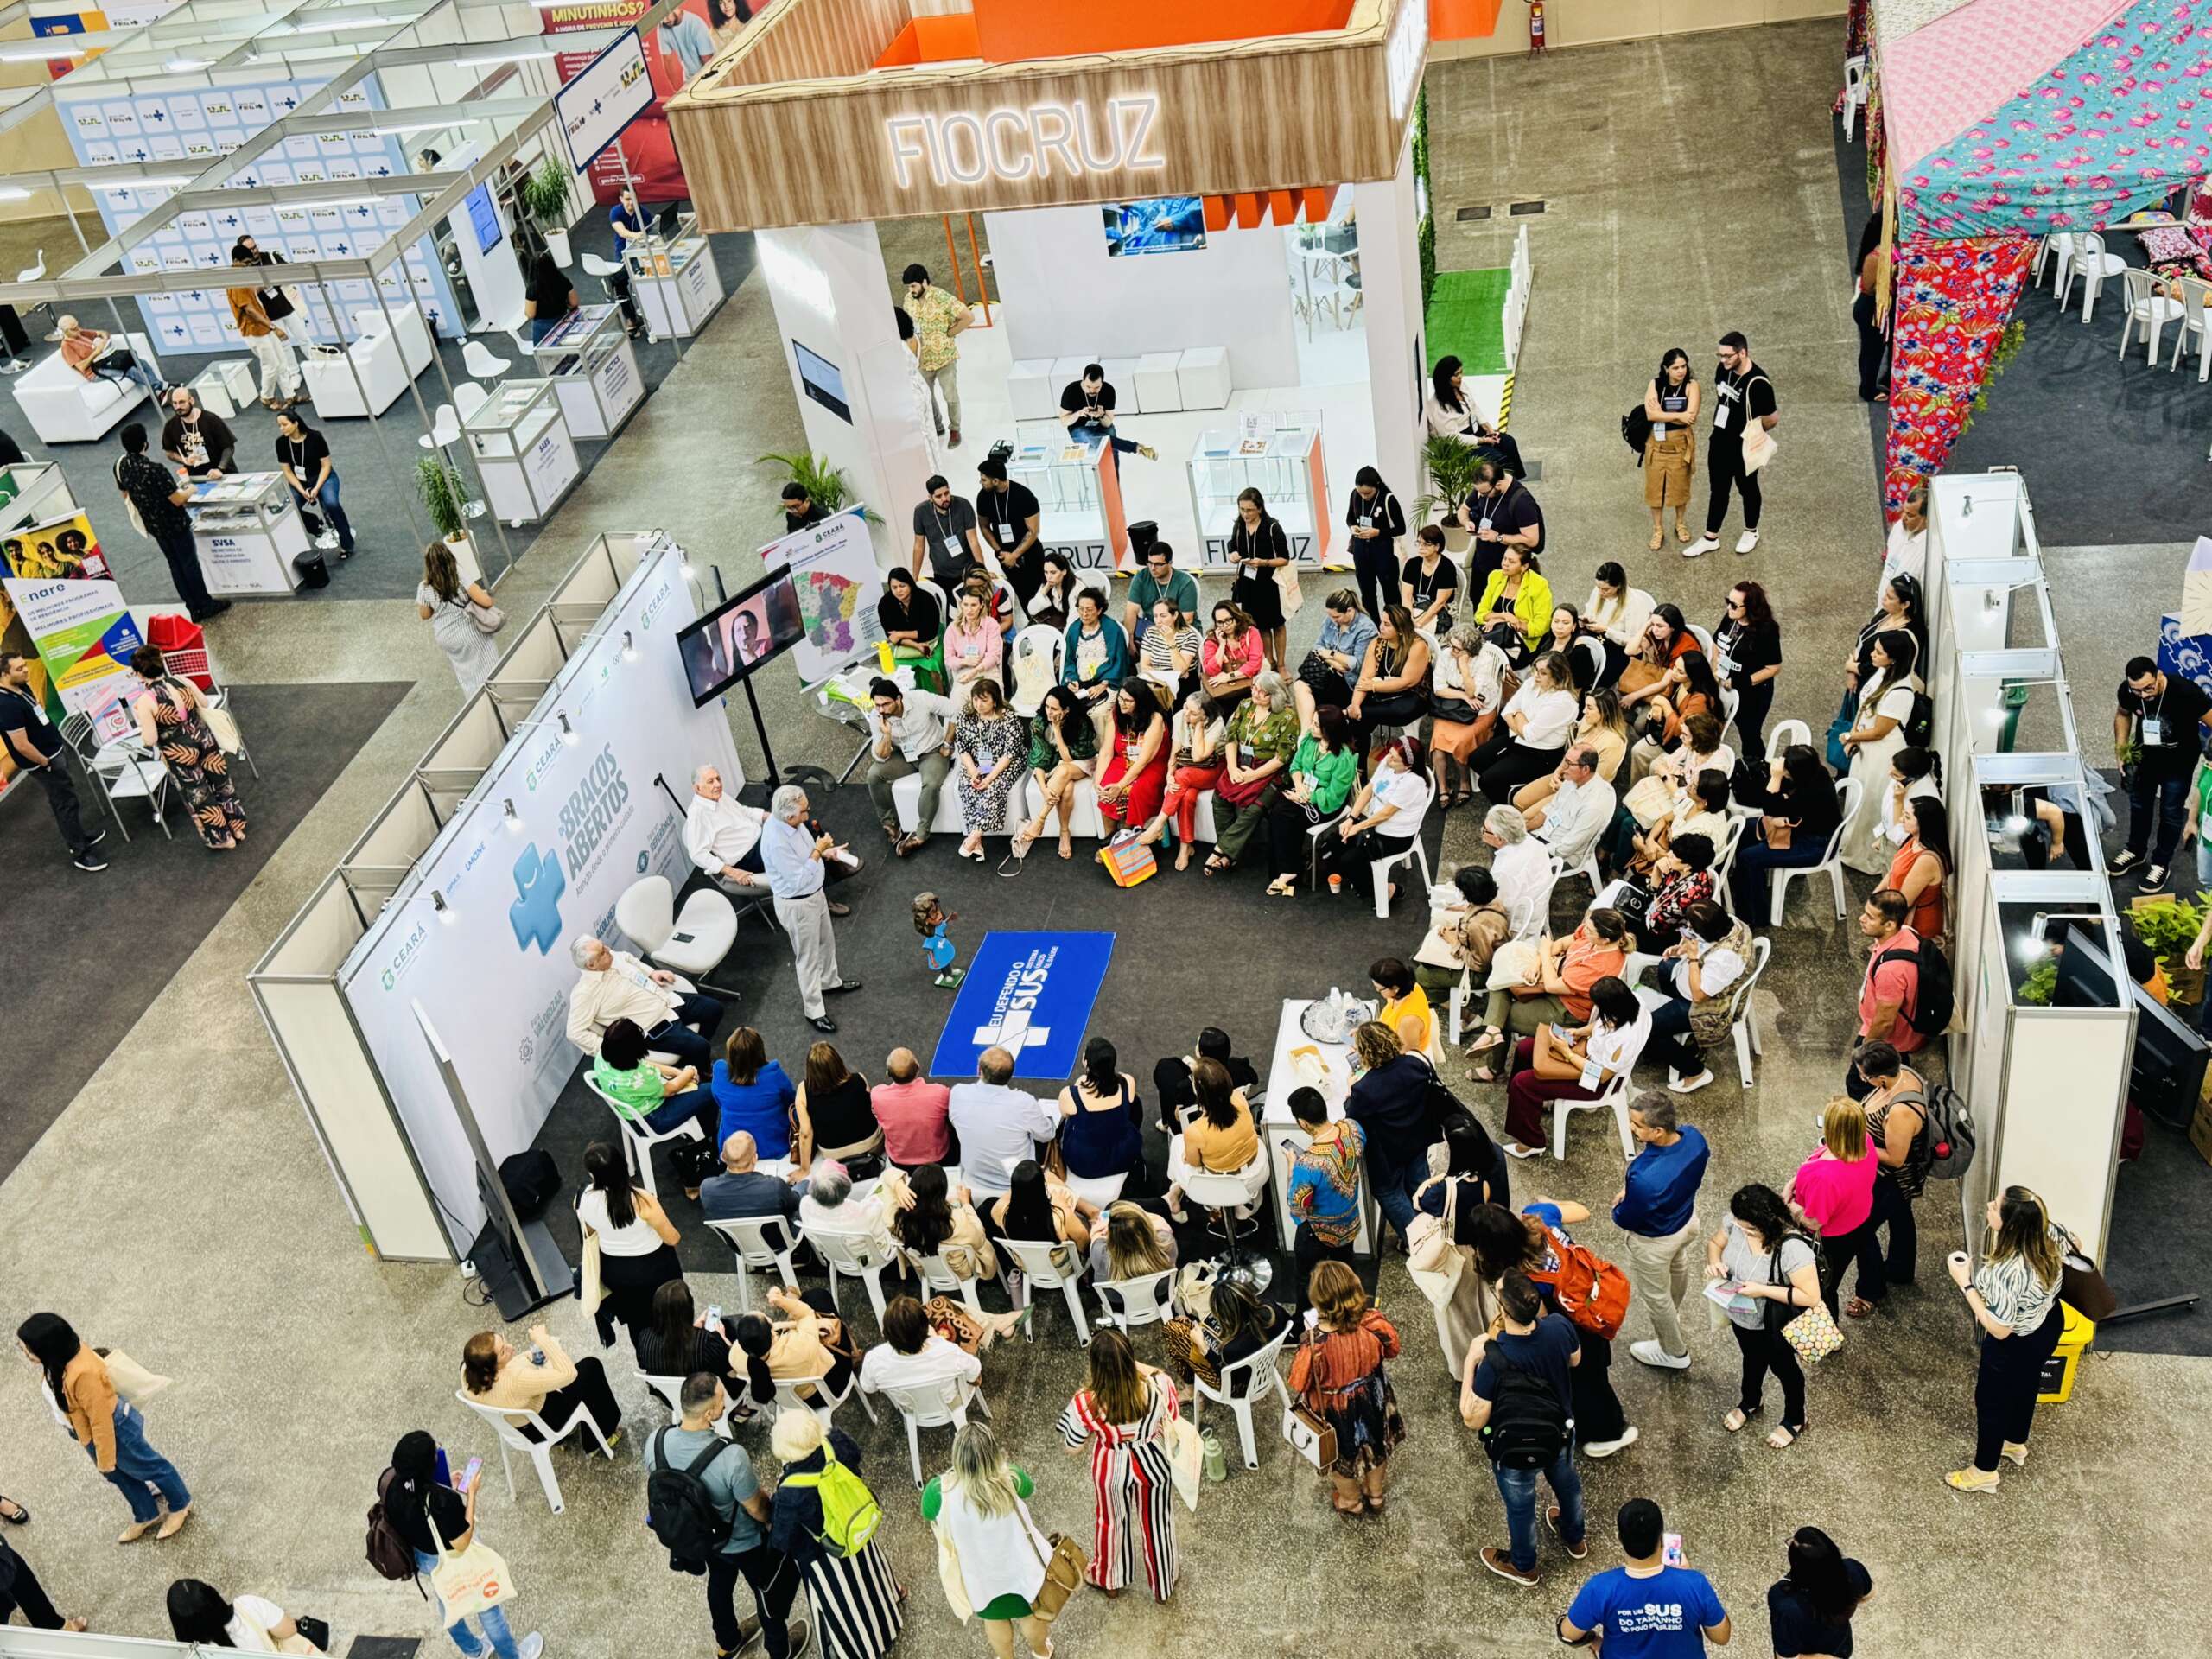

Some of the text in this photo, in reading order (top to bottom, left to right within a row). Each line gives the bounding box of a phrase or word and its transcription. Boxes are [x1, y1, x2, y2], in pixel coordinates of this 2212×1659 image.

[551, 1, 645, 22] MINUTINHOS?
[887, 98, 1164, 188] FIOCRUZ
[823, 522, 844, 537] CEARÁ
[648, 579, 671, 614] CEARÁ
[536, 733, 563, 773] CEARÁ
[566, 769, 629, 881] ABERTOS
[393, 921, 426, 969] CEARÁ
[988, 961, 1026, 1027] EU DEFENDO O
[1010, 968, 1048, 1010] SUS
[1636, 1616, 1683, 1624] TAMANHO
[1644, 1603, 1682, 1617] SUS
